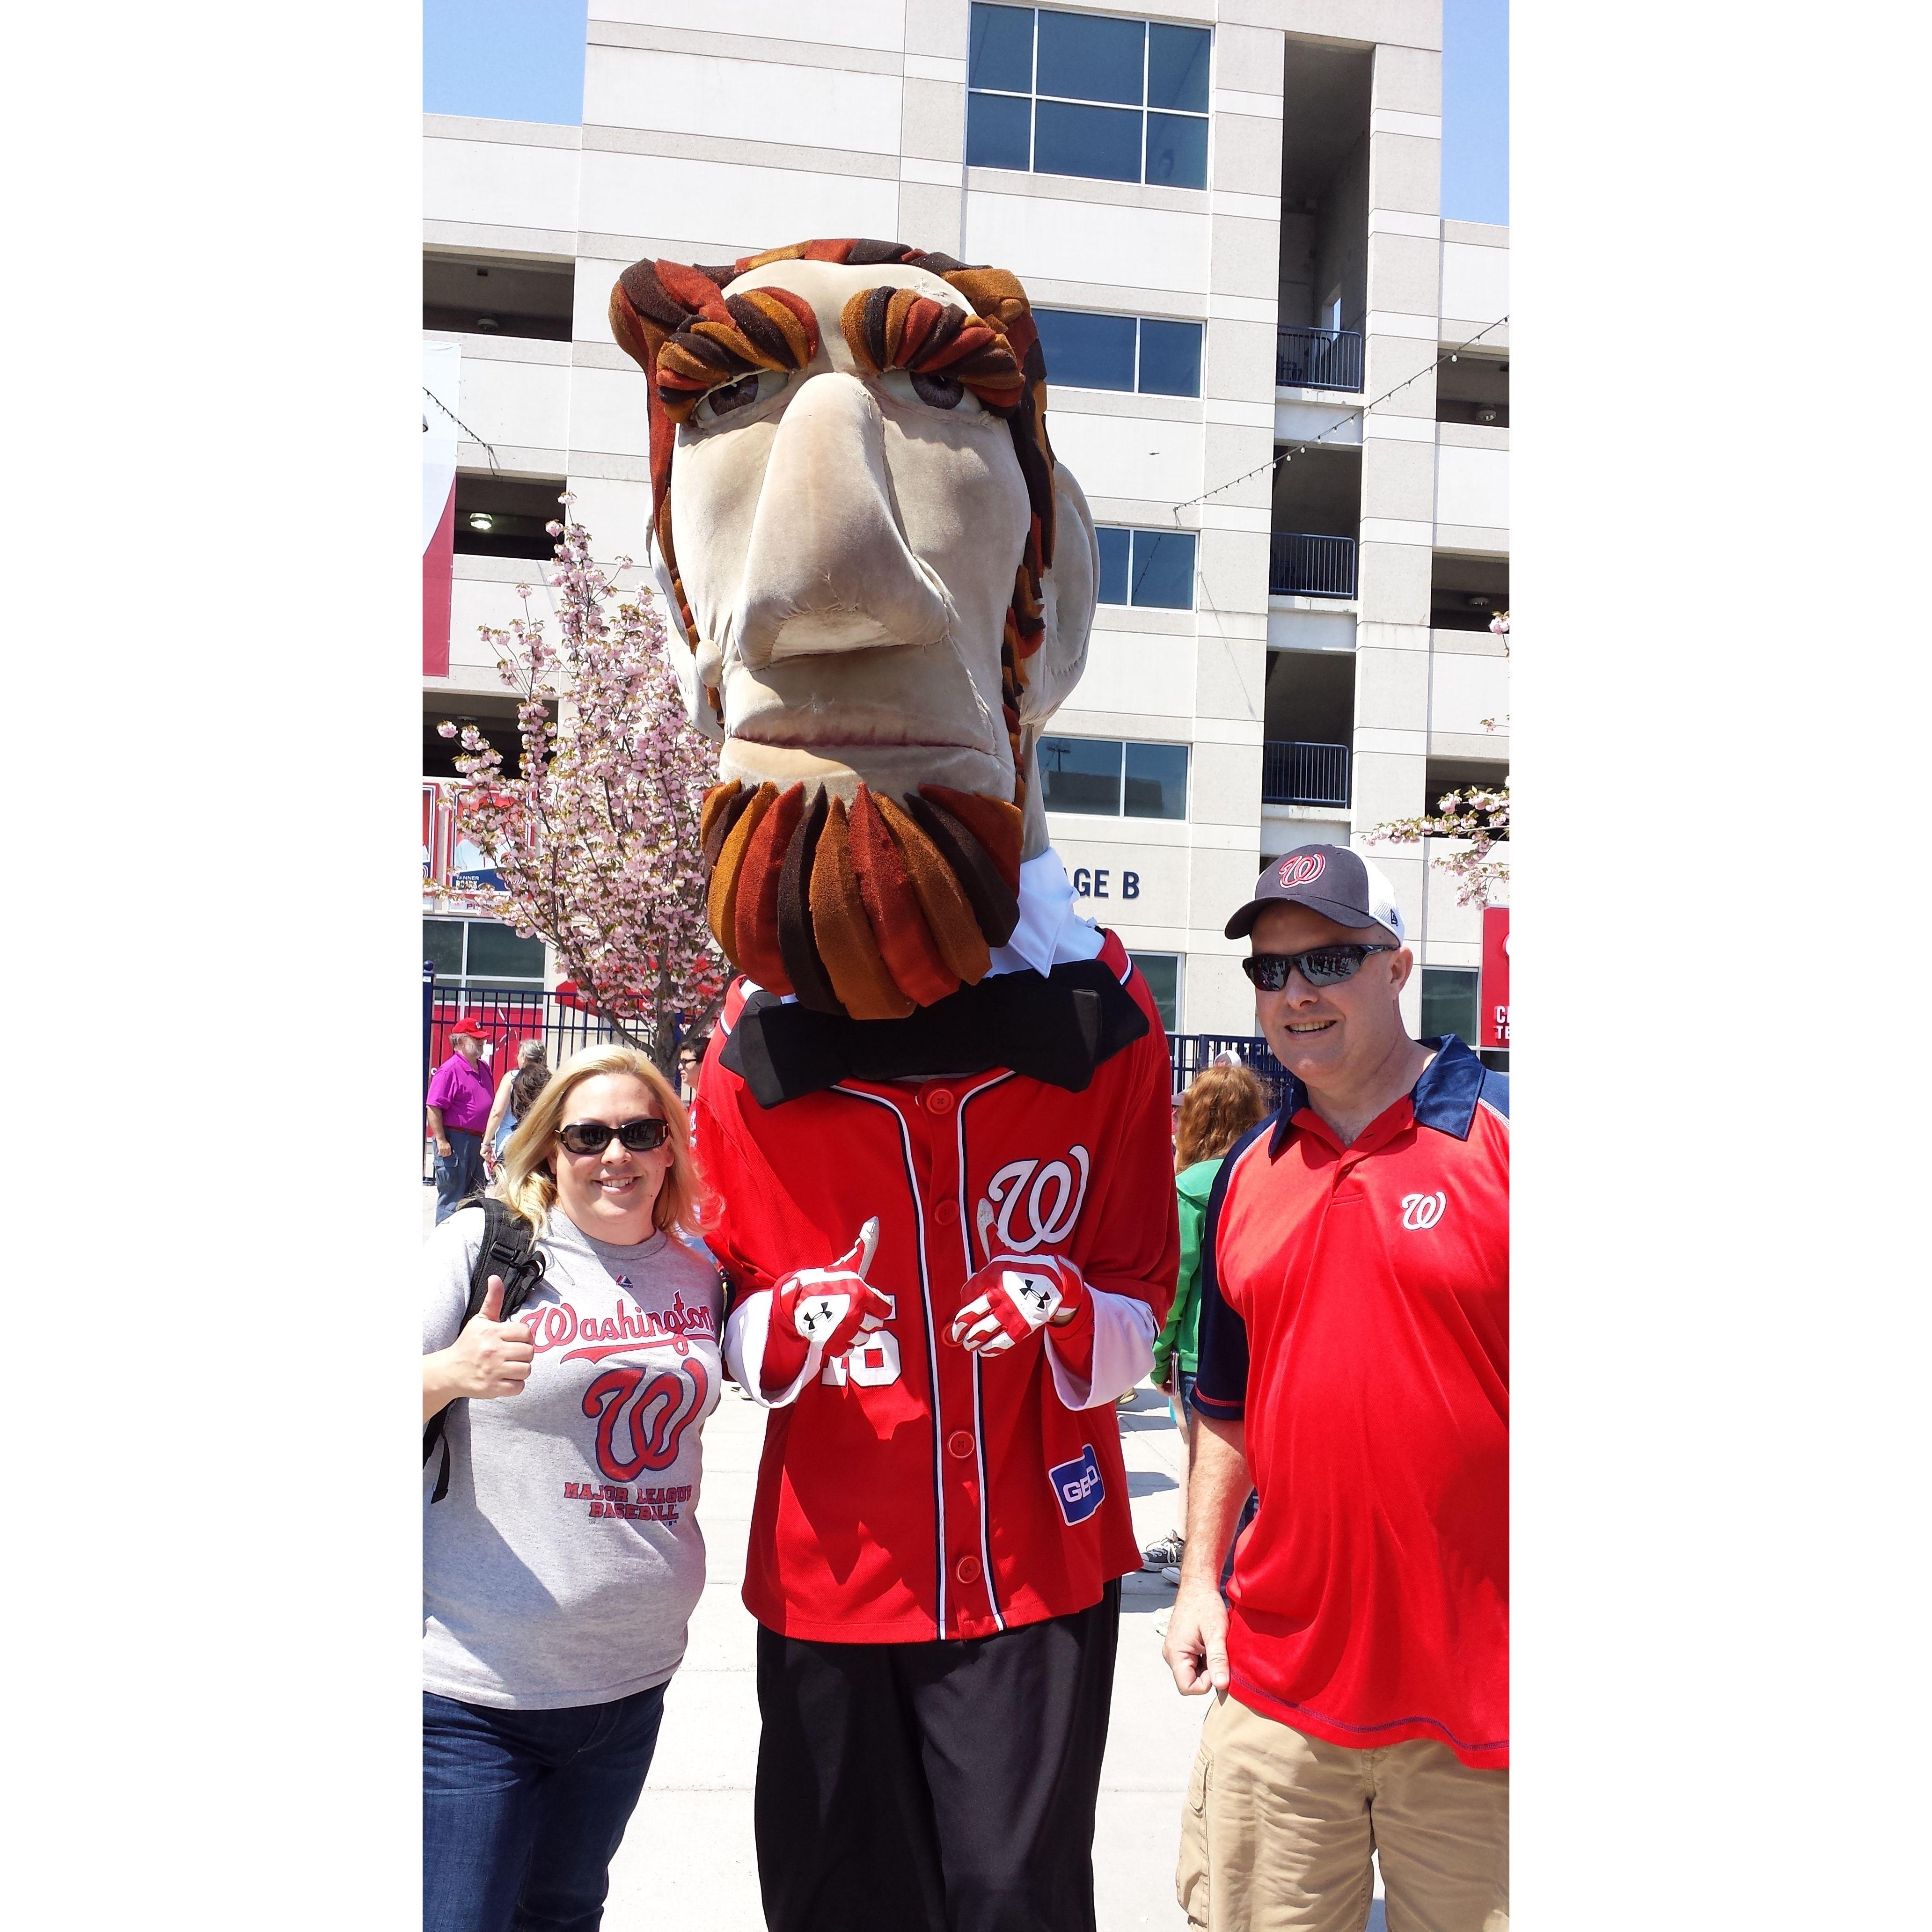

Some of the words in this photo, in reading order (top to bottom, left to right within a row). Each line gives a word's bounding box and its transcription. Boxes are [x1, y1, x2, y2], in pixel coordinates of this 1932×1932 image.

[1064, 867, 1110, 898] GE
[1123, 871, 1140, 899] B
[1279, 853, 1326, 888] W
[987, 1145, 1090, 1253] W
[1400, 1190, 1447, 1231] W
[520, 1289, 715, 1356] Washington
[582, 1357, 708, 1483] W
[564, 1482, 629, 1502] MAJOR
[589, 1501, 679, 1521] BASEBALL
